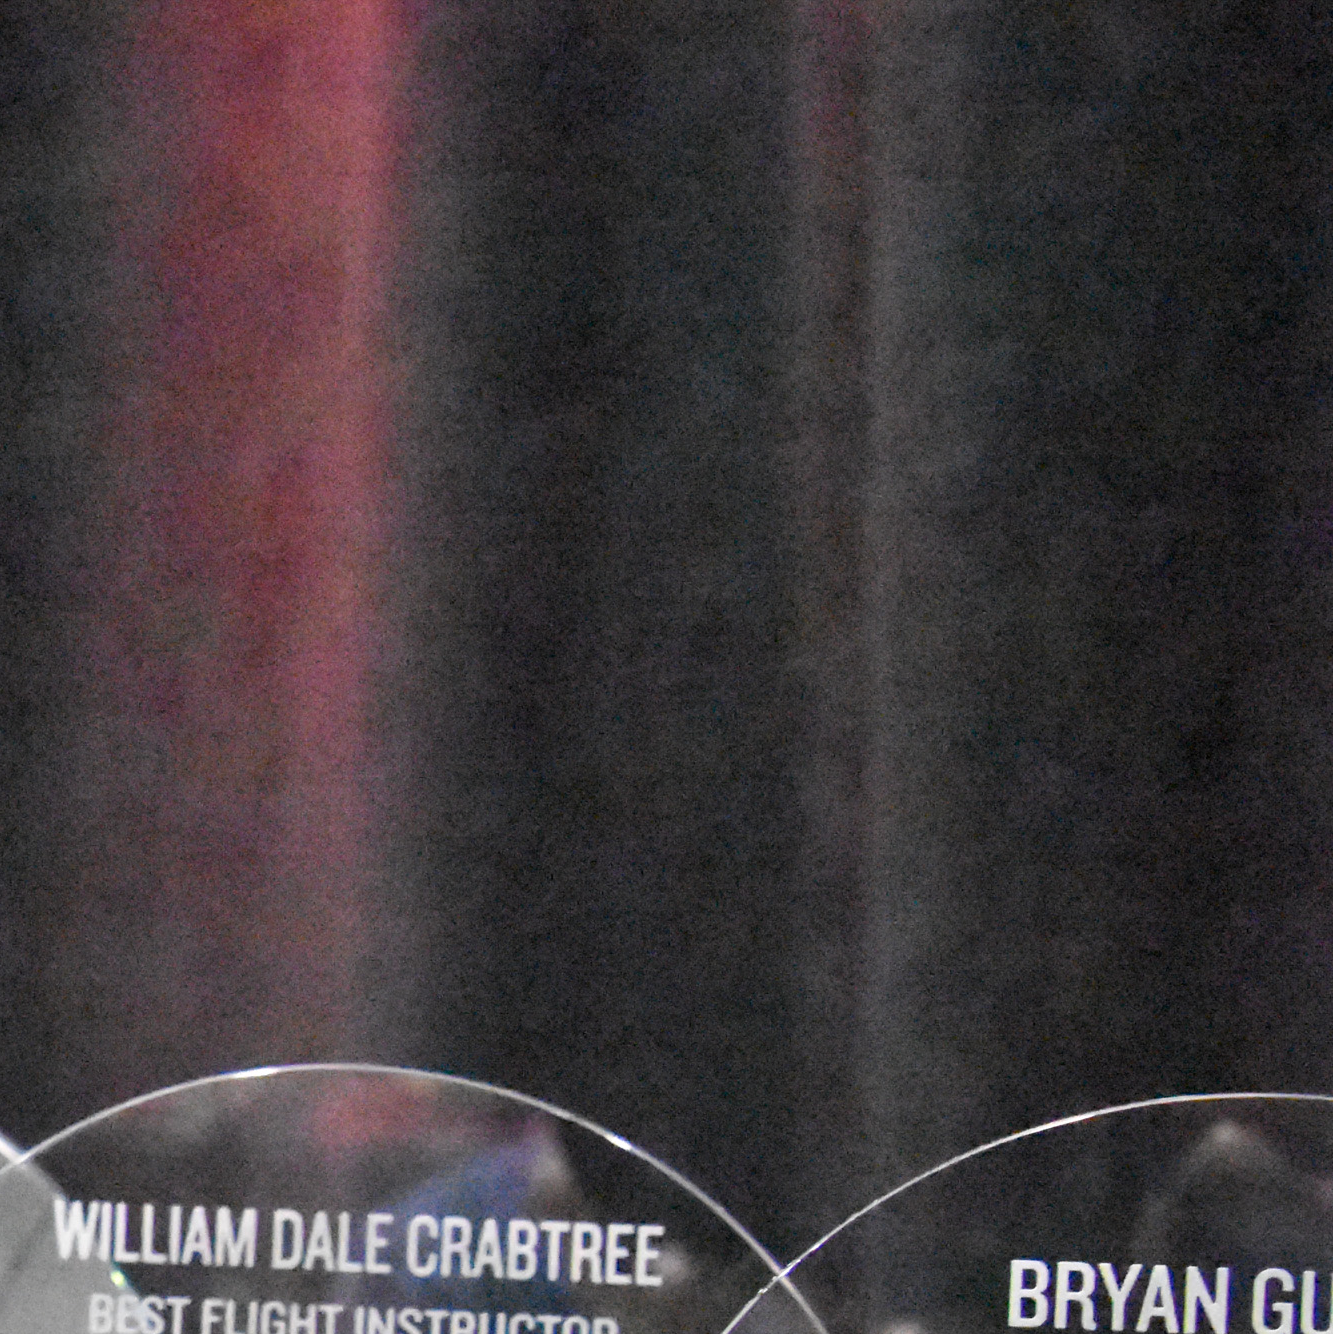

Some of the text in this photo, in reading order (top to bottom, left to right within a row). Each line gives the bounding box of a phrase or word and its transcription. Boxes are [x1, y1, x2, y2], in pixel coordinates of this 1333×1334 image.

[53, 1200, 665, 1287] WILLIAM DALE CRABTREE
